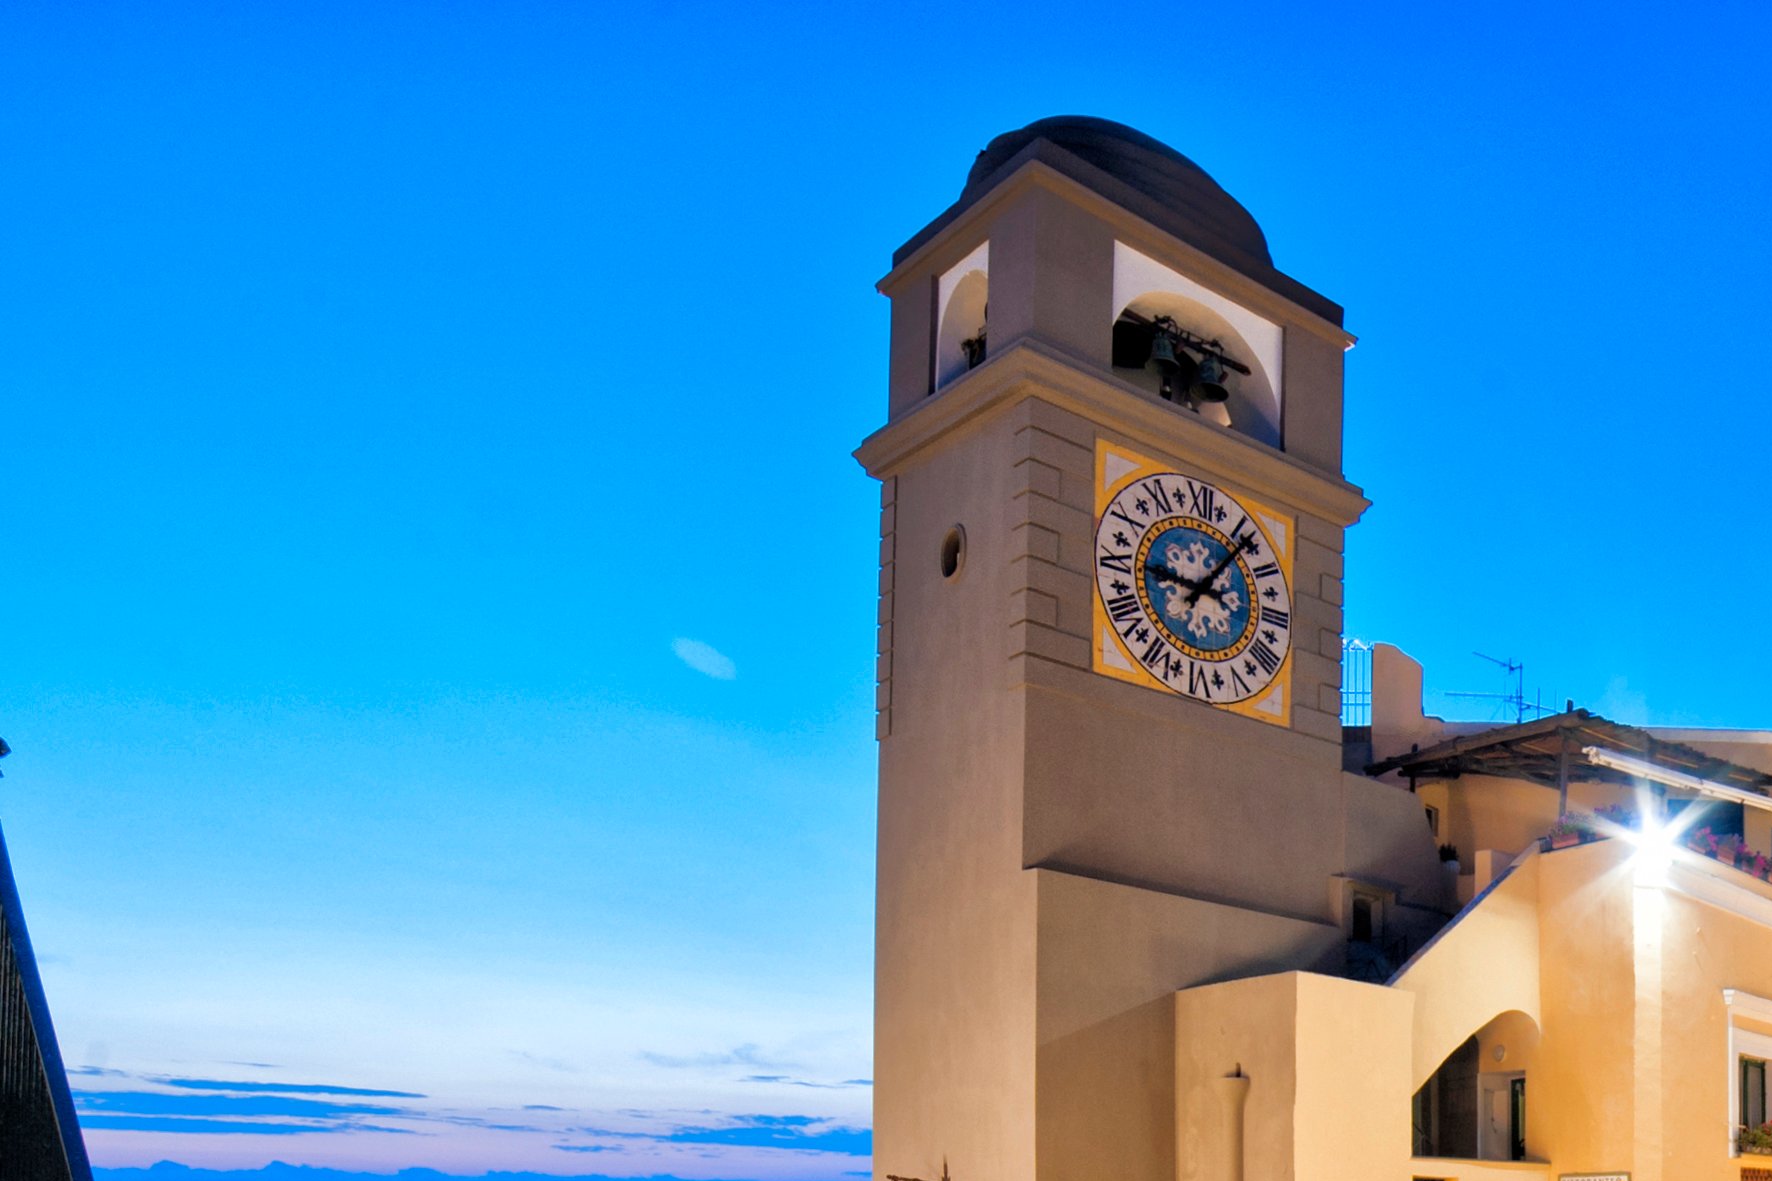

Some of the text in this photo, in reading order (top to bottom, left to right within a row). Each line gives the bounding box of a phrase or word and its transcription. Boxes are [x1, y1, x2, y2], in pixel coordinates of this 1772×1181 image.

[1142, 479, 1174, 517] XI
[1188, 481, 1214, 522] XII
[1111, 501, 1146, 538] X
[1230, 515, 1247, 539] I
[1100, 544, 1132, 575] IX
[1253, 562, 1279, 579] II
[1107, 594, 1144, 640] VIII
[1261, 606, 1289, 631] III
[1140, 636, 1172, 682] VII
[1249, 638, 1281, 676] IIII
[1189, 661, 1211, 699] VI
[1231, 665, 1252, 698] V
